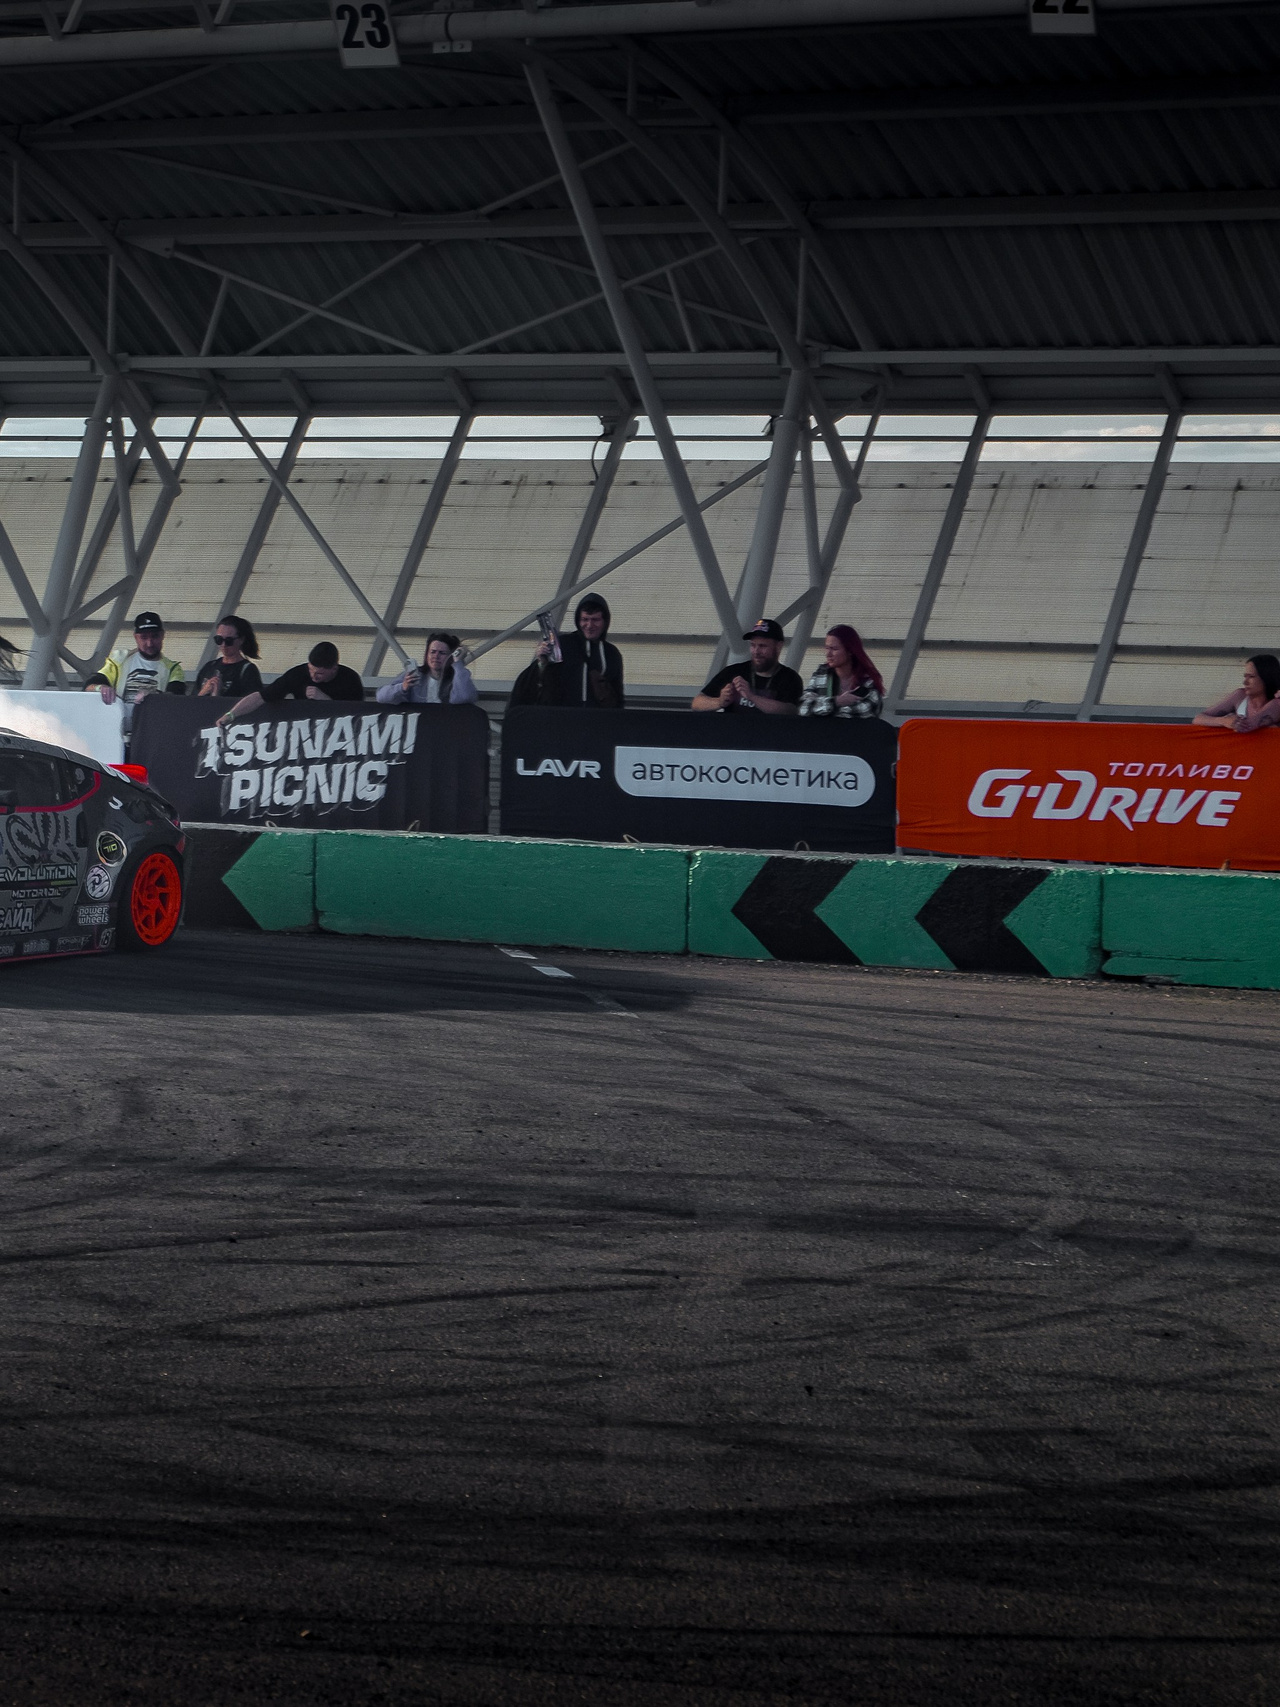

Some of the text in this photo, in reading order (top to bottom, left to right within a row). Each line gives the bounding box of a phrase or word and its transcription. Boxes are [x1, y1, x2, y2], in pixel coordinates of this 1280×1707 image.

[336, 3, 391, 48] 23
[200, 711, 422, 771] TSUNAMI
[516, 758, 602, 779] LAVR
[631, 762, 859, 791] автокосметика
[1108, 762, 1254, 780] ТОПЛИВО
[228, 760, 389, 811] PICNIC
[78, 906, 108, 917] power
[78, 913, 109, 924] wheels
